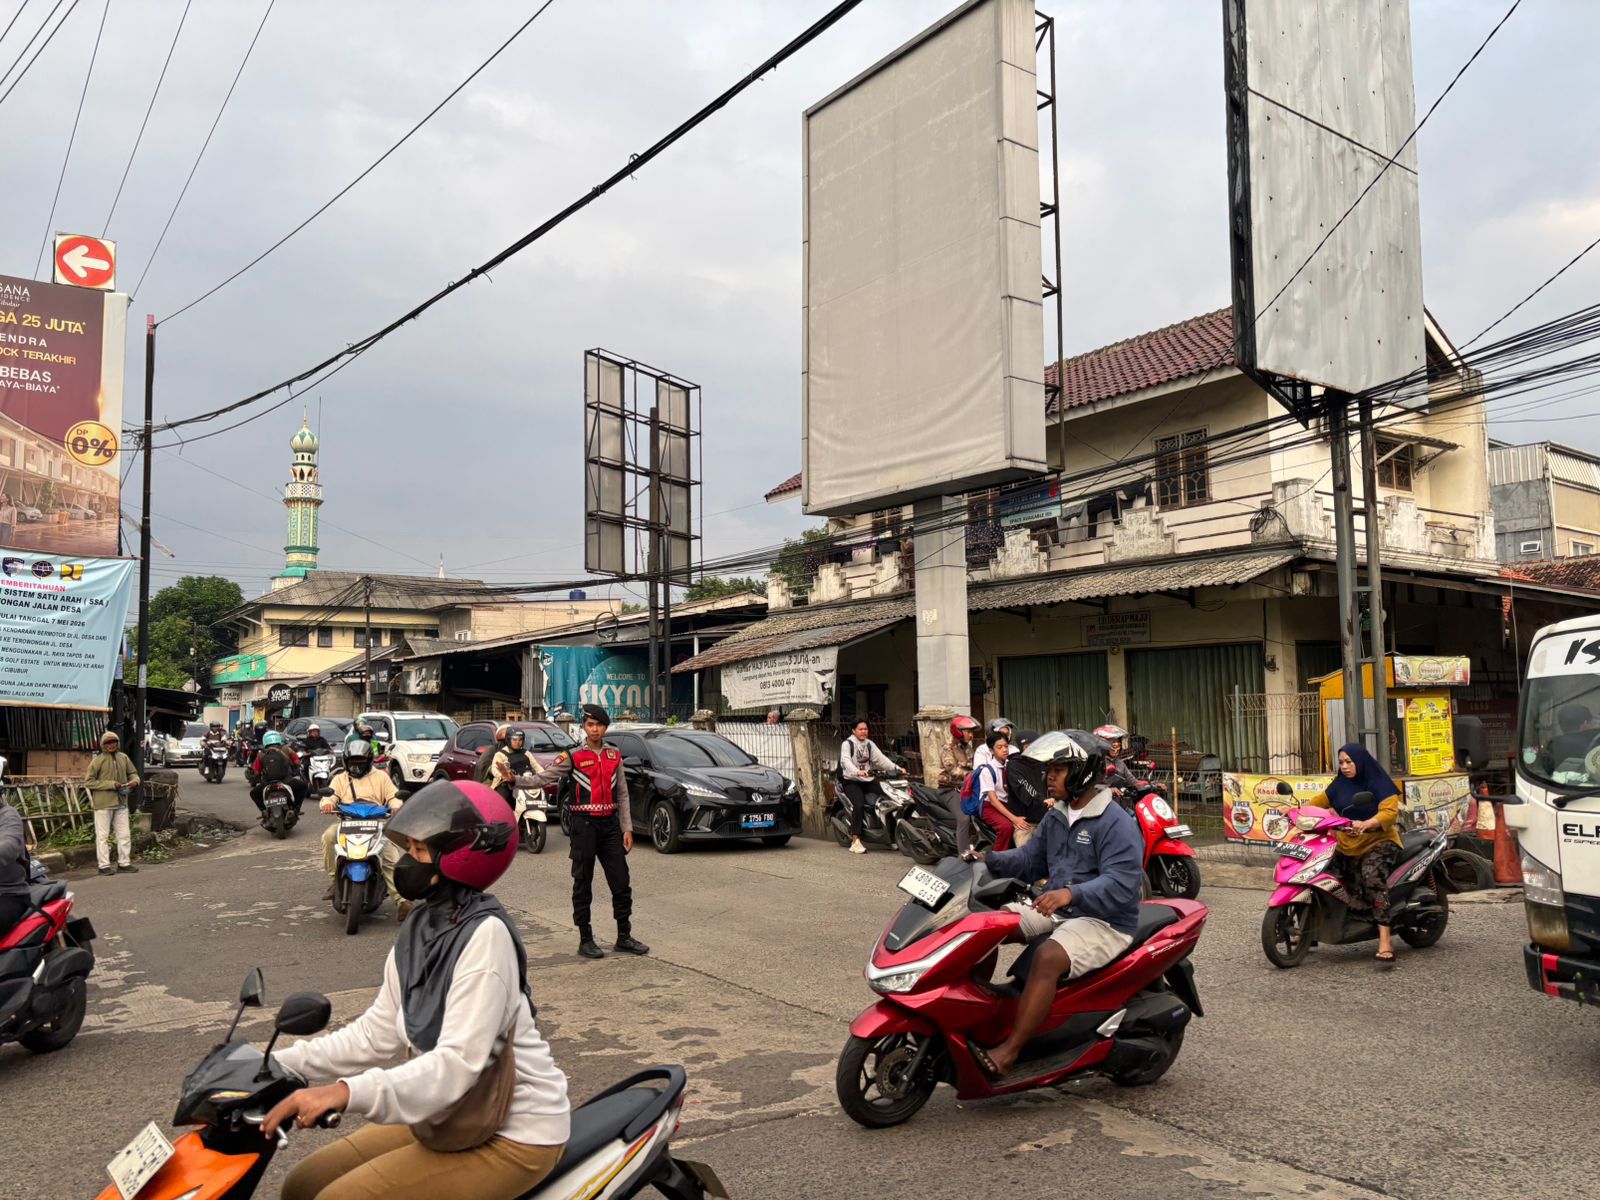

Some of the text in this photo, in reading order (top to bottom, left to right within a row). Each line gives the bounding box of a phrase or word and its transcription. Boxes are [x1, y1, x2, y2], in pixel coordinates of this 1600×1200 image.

[22, 313, 42, 328] 25
[22, 350, 76, 365] TERAKHIR
[0, 365, 52, 383] BEBAS
[76, 428, 88, 436] DP
[4, 588, 35, 598] SISTEM
[37, 592, 58, 600] SATU
[60, 595, 82, 604] ARAH
[89, 598, 104, 606] SSA
[32, 602, 58, 611] JALAN
[60, 605, 81, 614] DESA
[19, 614, 50, 624] TANGGAL
[2, 627, 36, 635] KENDARAAN
[37, 630, 66, 638] BERMOTOR
[12, 638, 50, 646] TEROWONGAN
[2, 646, 42, 656] MENGGUNAKAN
[764, 660, 777, 669] PLUS
[788, 655, 792, 665] 3
[636, 672, 646, 680] TO
[271, 689, 291, 697] VAPE
[271, 694, 291, 702] STORE
